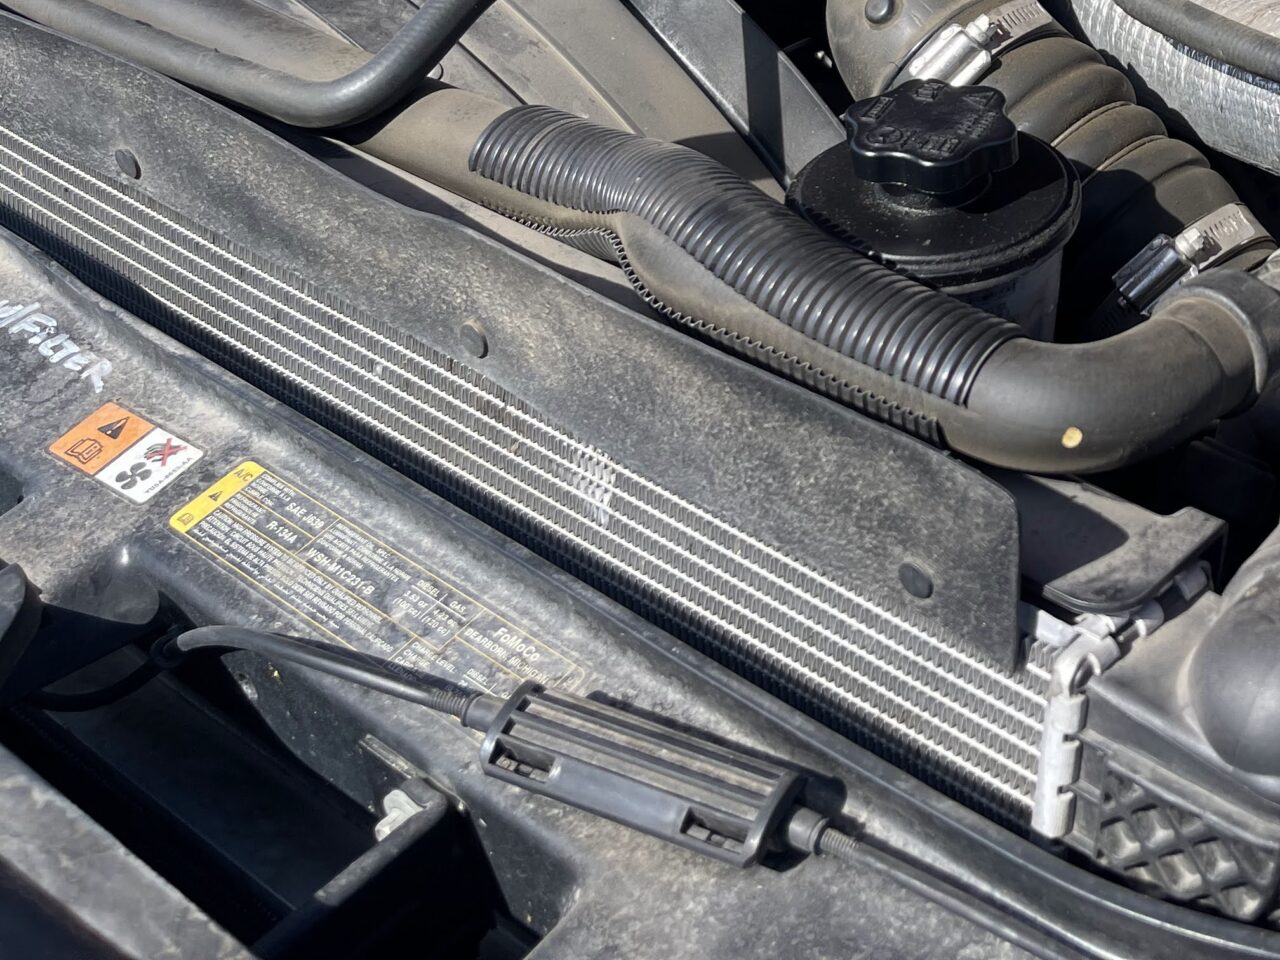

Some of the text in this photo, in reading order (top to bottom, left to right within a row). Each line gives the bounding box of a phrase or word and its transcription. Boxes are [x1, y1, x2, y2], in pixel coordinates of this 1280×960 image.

[232, 466, 254, 482] A/C
[283, 501, 326, 530] SAE J639
[264, 519, 300, 544] R-134A
[302, 546, 378, 596] WSH-M1C231-B
[414, 578, 442, 598] DIESEL
[491, 626, 545, 662] FoMoCo
